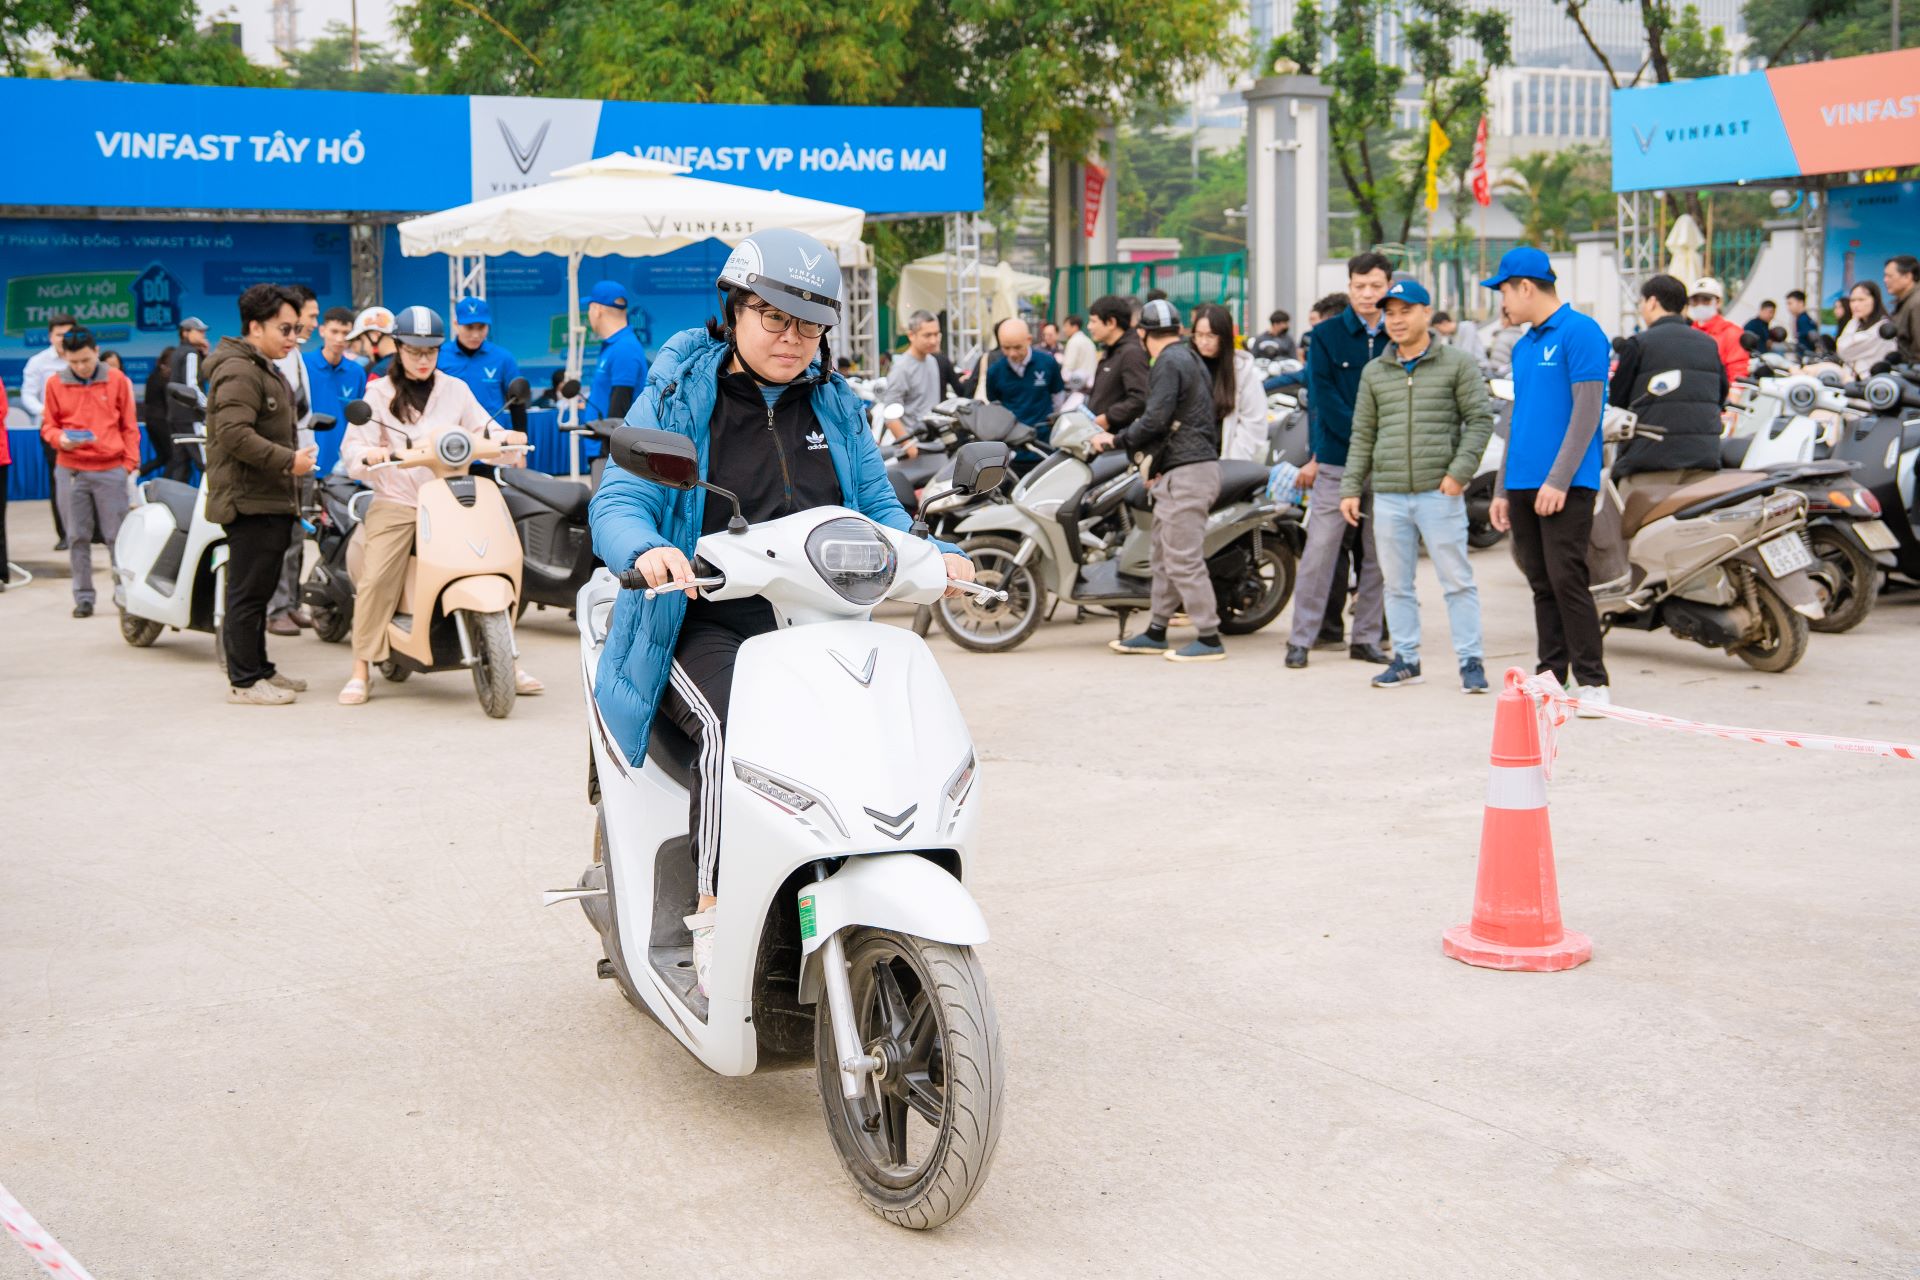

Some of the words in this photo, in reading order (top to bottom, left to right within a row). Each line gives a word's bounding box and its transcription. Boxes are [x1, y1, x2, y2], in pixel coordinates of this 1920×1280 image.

[1666, 120, 1749, 142] VINFAST
[95, 131, 242, 161] VINFAST
[249, 130, 311, 163] TÂY
[317, 129, 366, 165] HỒ
[633, 145, 750, 171] VINFAST
[756, 147, 793, 171] VP
[799, 142, 894, 172] HOÀNG
[901, 149, 947, 171] MAI
[673, 221, 754, 232] VINFAST
[133, 236, 185, 248] VINFAST
[789, 267, 825, 284] VINFAST
[37, 281, 82, 298] NGÀY
[86, 279, 117, 297] HỘI
[73, 300, 130, 320] XĂNG
